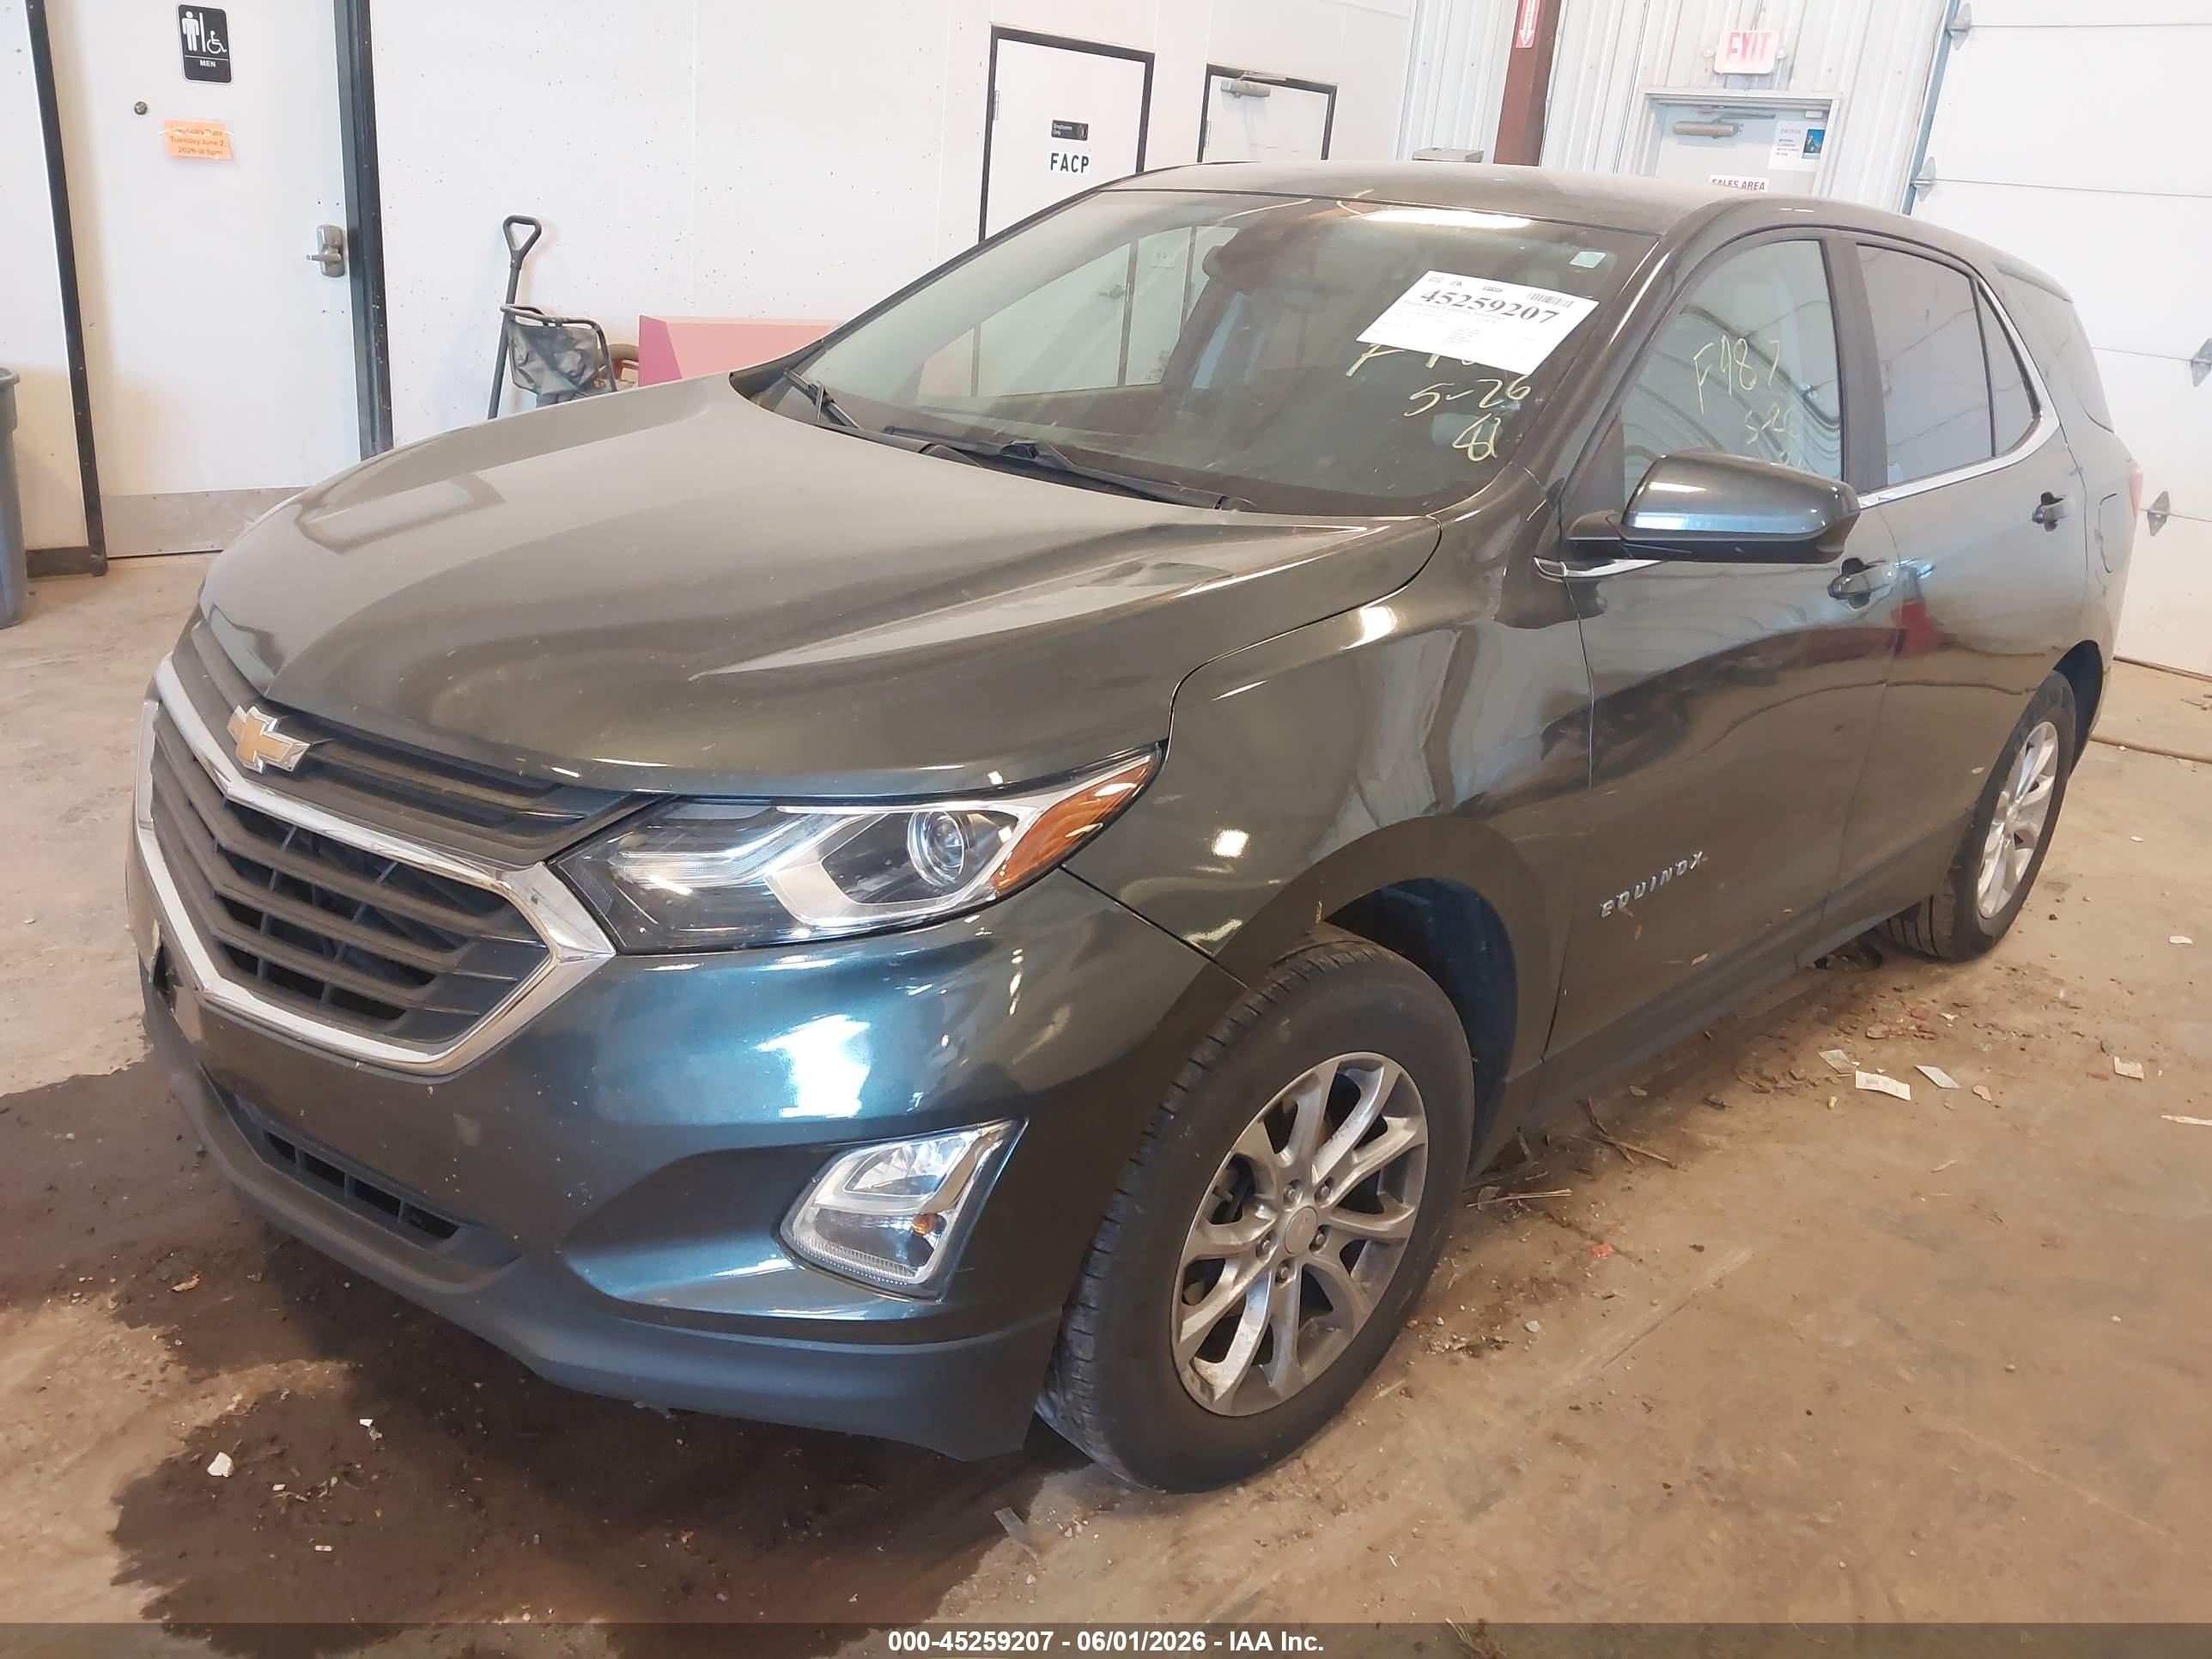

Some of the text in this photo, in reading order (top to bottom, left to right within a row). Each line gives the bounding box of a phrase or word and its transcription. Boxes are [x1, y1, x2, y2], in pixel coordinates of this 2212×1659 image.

[1726, 32, 1772, 64] EXIT
[199, 59, 216, 68] MEN
[1050, 152, 1089, 173] FACP
[1741, 180, 1765, 191] AREA
[1419, 289, 1561, 324] 45259207
[1600, 851, 1709, 918] EQUINOX
